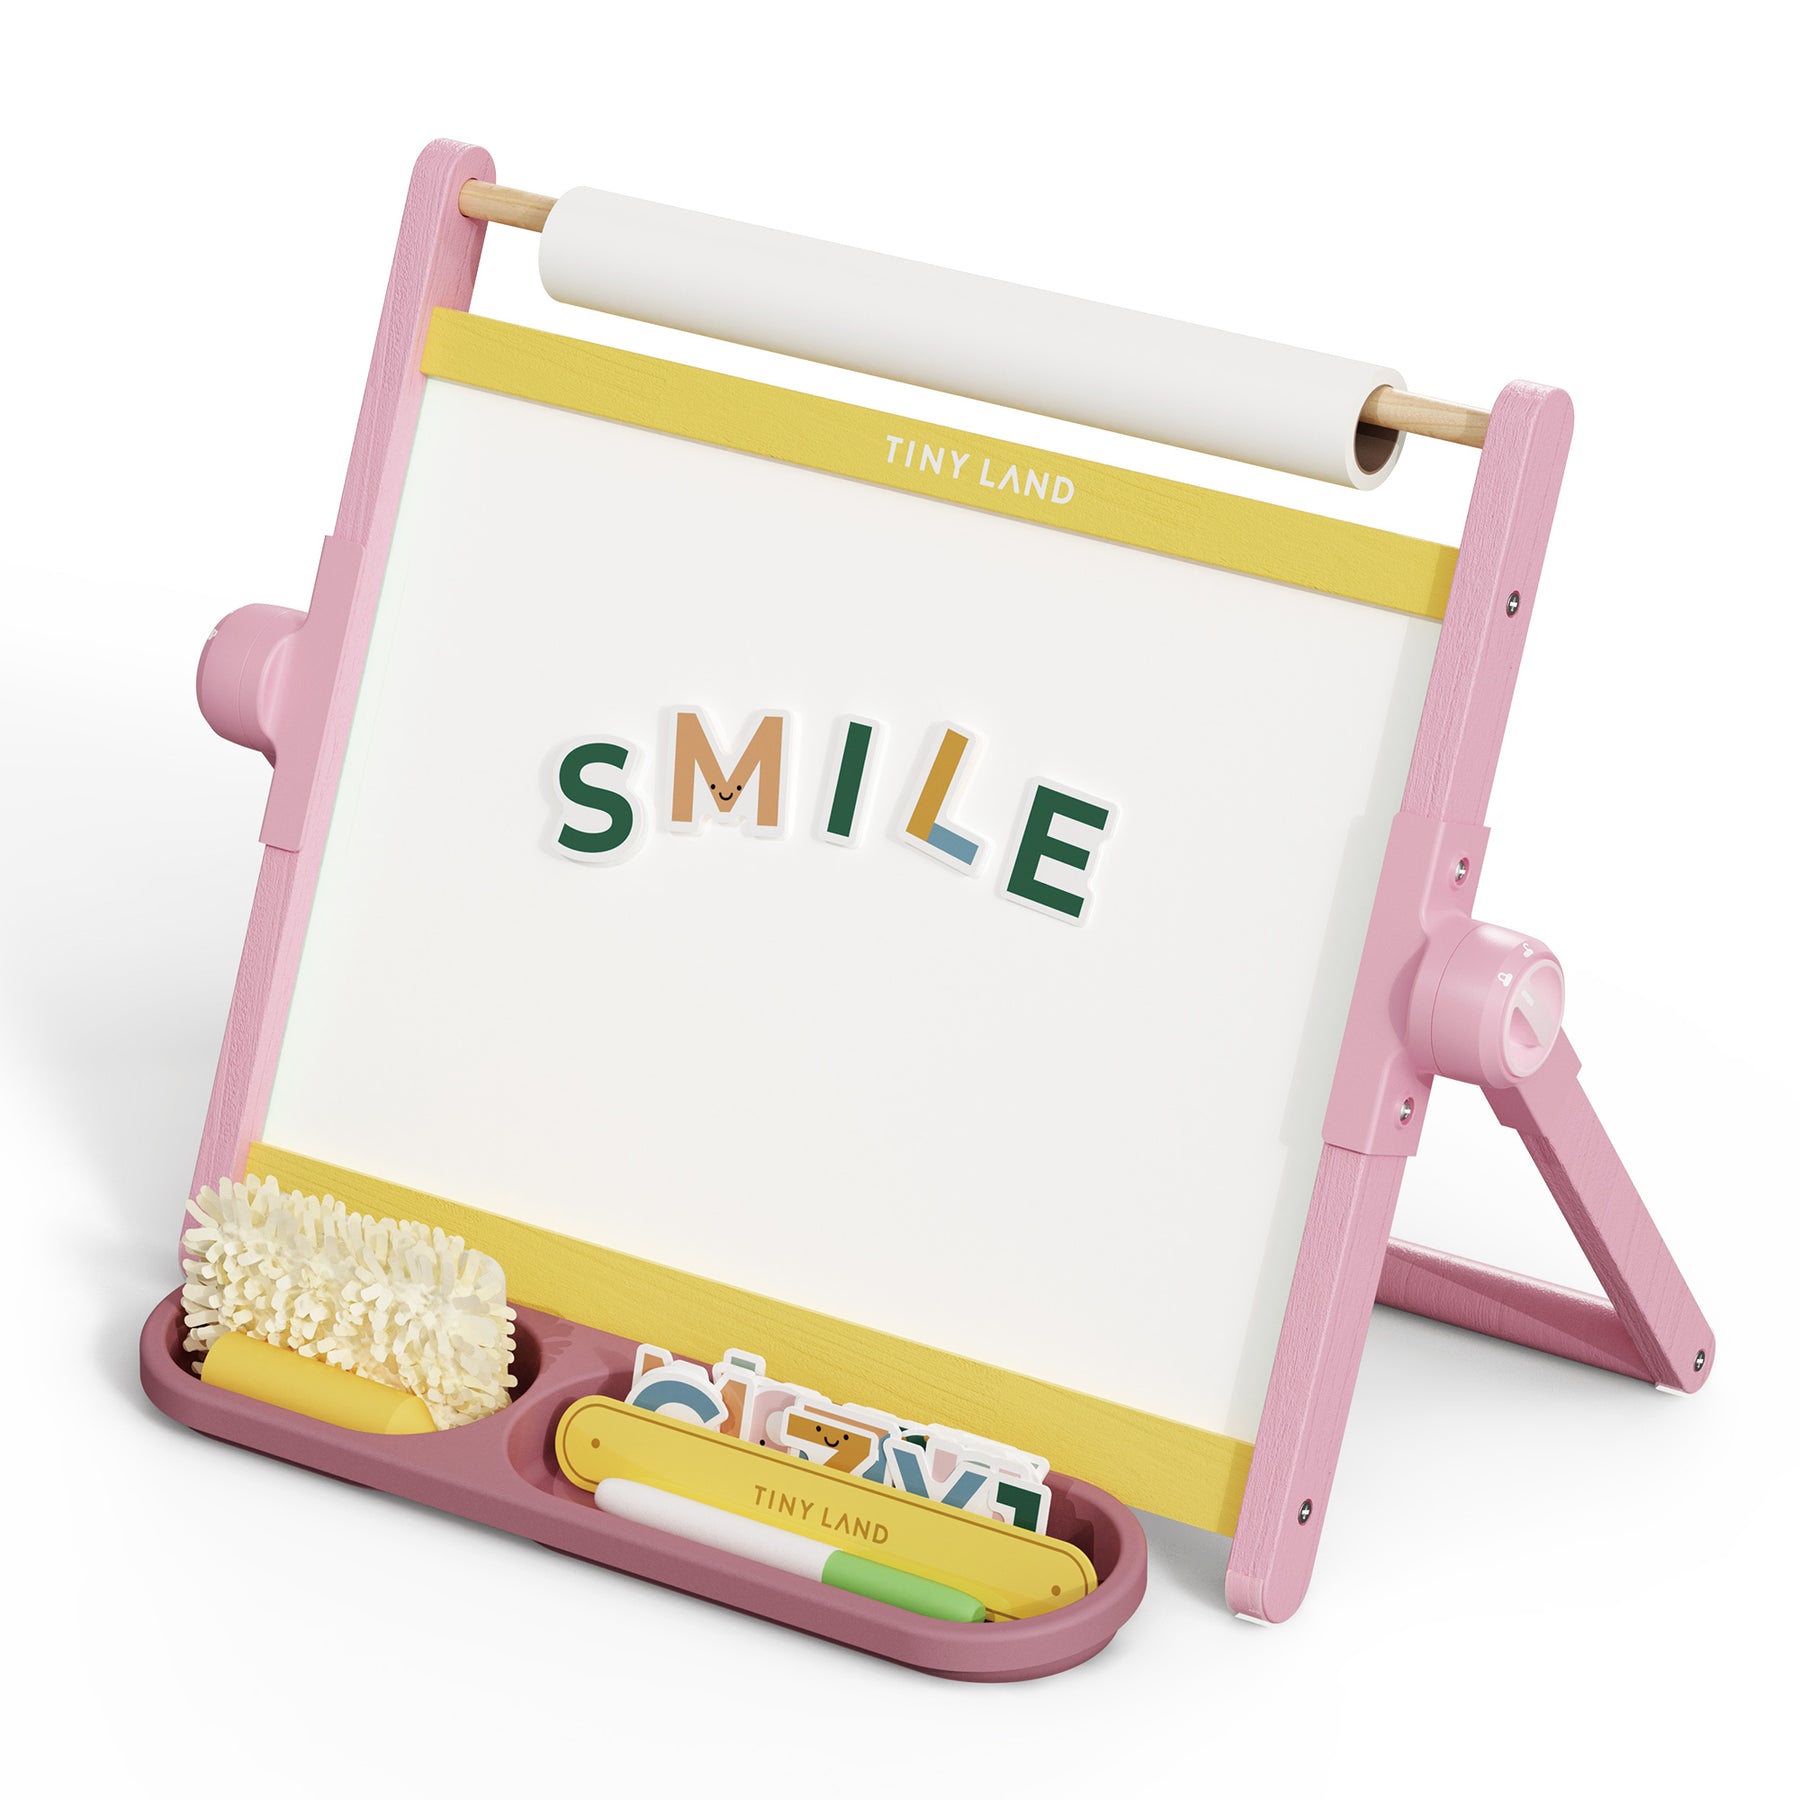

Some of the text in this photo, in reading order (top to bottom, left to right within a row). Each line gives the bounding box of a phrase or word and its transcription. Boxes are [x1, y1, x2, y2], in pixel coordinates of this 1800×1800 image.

[886, 434, 1075, 505] TINY LAND
[557, 711, 1110, 919] SMILE
[754, 1484, 889, 1545] TINY LAND
